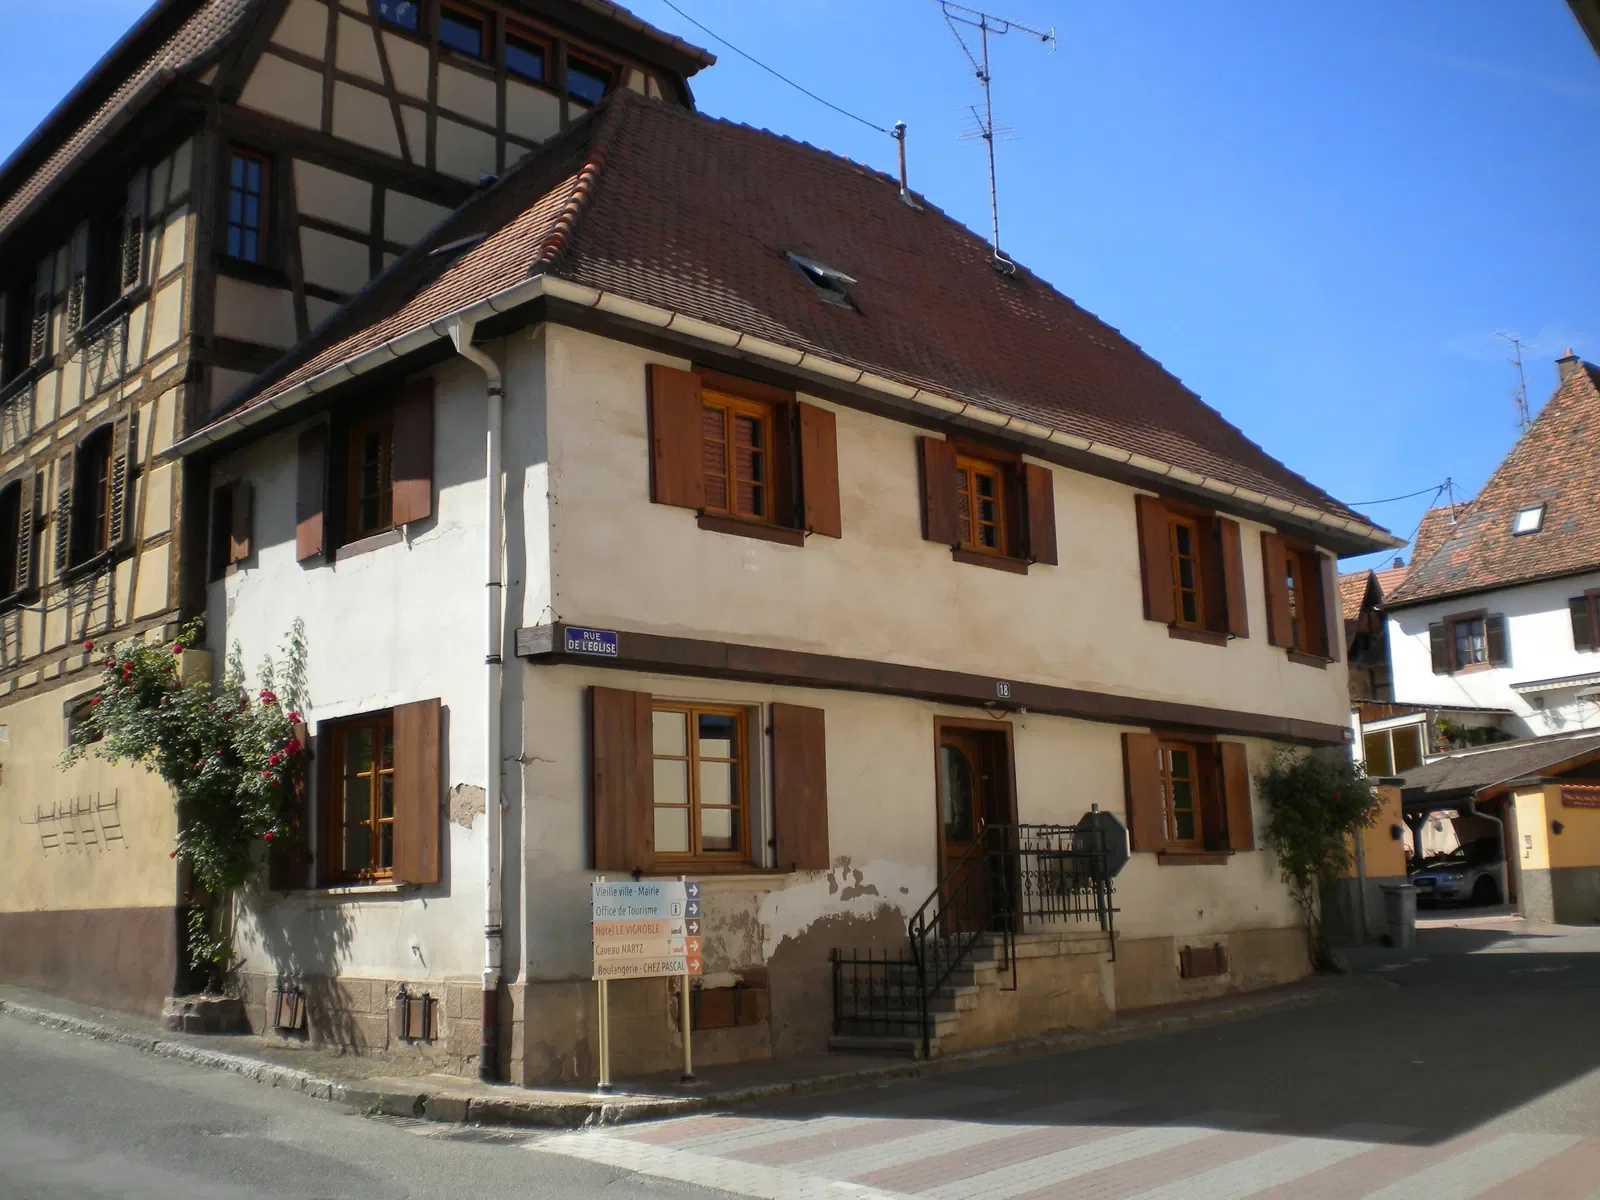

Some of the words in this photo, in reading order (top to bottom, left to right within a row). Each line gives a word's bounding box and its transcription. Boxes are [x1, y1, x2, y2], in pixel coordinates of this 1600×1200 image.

[583, 632, 601, 640] RUE
[568, 640, 580, 649] DE
[1000, 684, 1009, 696] 18
[596, 886, 617, 896] Vieille
[619, 886, 633, 896] ville
[638, 886, 660, 896] Mairie
[595, 906, 616, 916] Office
[618, 905, 626, 916] de
[628, 905, 658, 916] Tourisme
[616, 925, 624, 936] LE
[625, 923, 660, 935] VIGNOBLE
[595, 944, 620, 956] Caveau
[621, 943, 644, 955] NARTZ
[598, 964, 639, 976] Boulangerie
[643, 963, 660, 972] CHEZ
[661, 961, 685, 973] PASCAL
